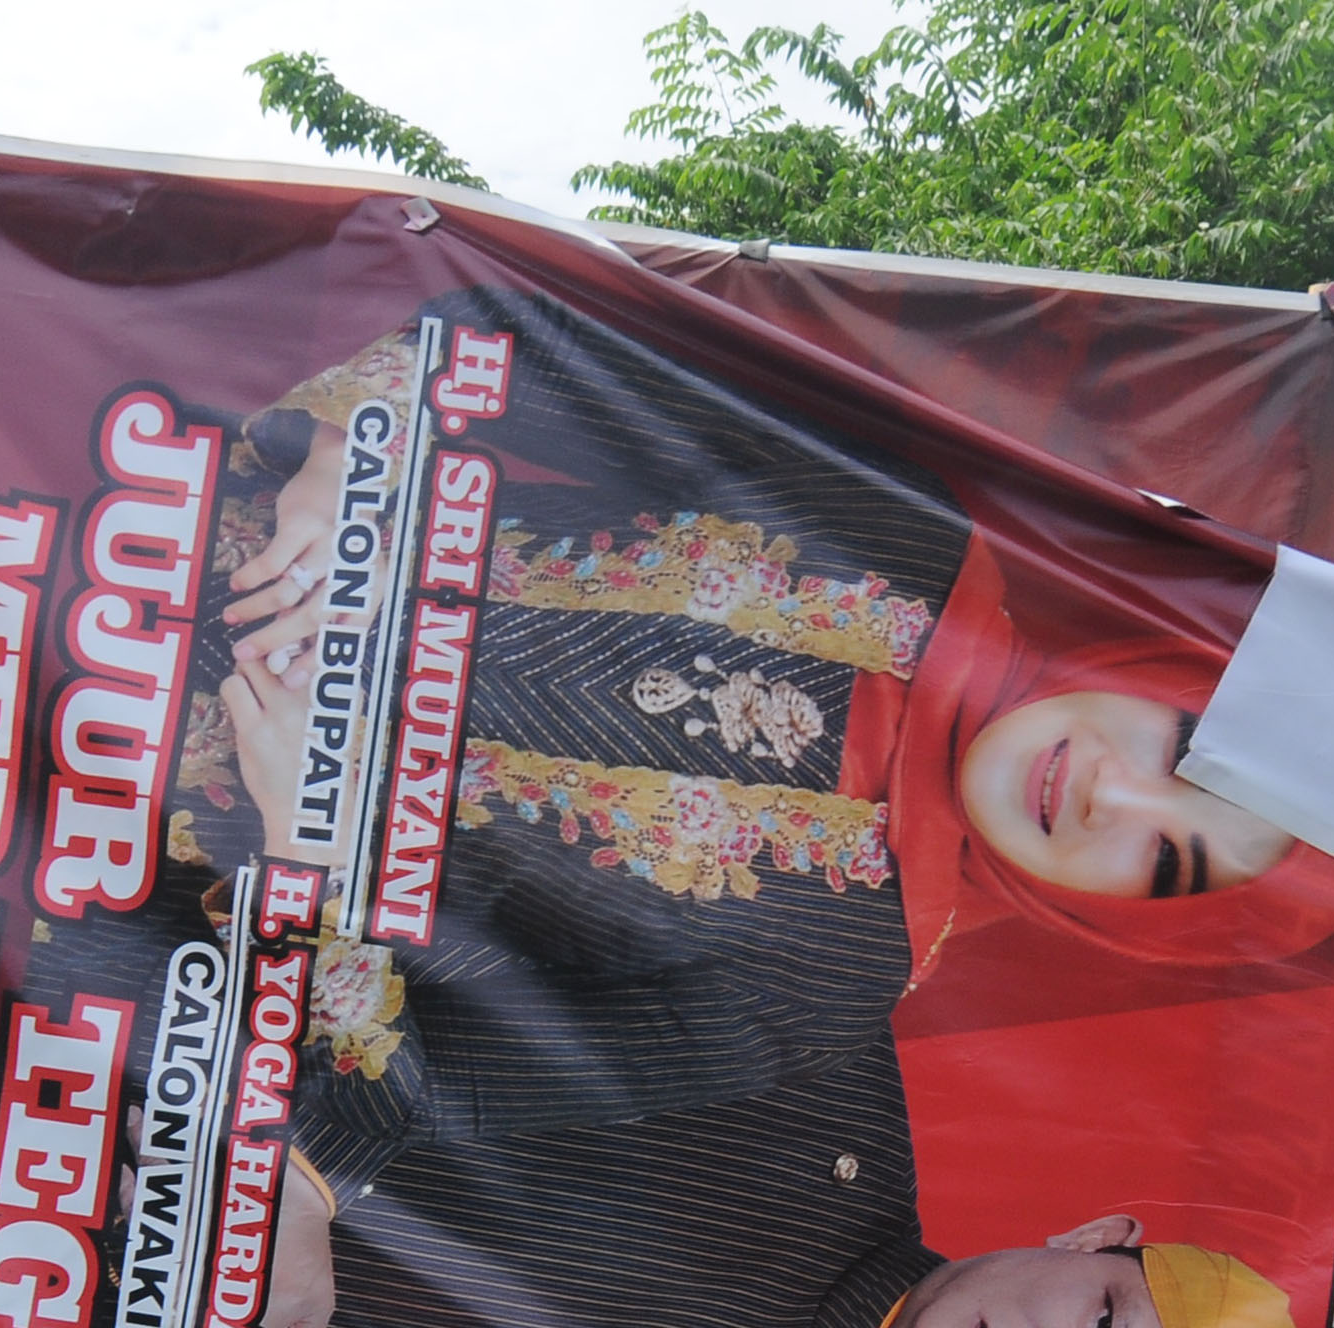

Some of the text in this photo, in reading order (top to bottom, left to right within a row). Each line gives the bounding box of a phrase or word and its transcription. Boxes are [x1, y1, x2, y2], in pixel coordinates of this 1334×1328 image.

[39, 395, 219, 908] JUJUR
[297, 404, 393, 842] CALON BUPATI
[375, 328, 511, 945] Hj. SRI MULYANI
[150, 948, 222, 1152] CALON
[233, 952, 307, 1132] YOGA
[260, 866, 320, 937] H.
